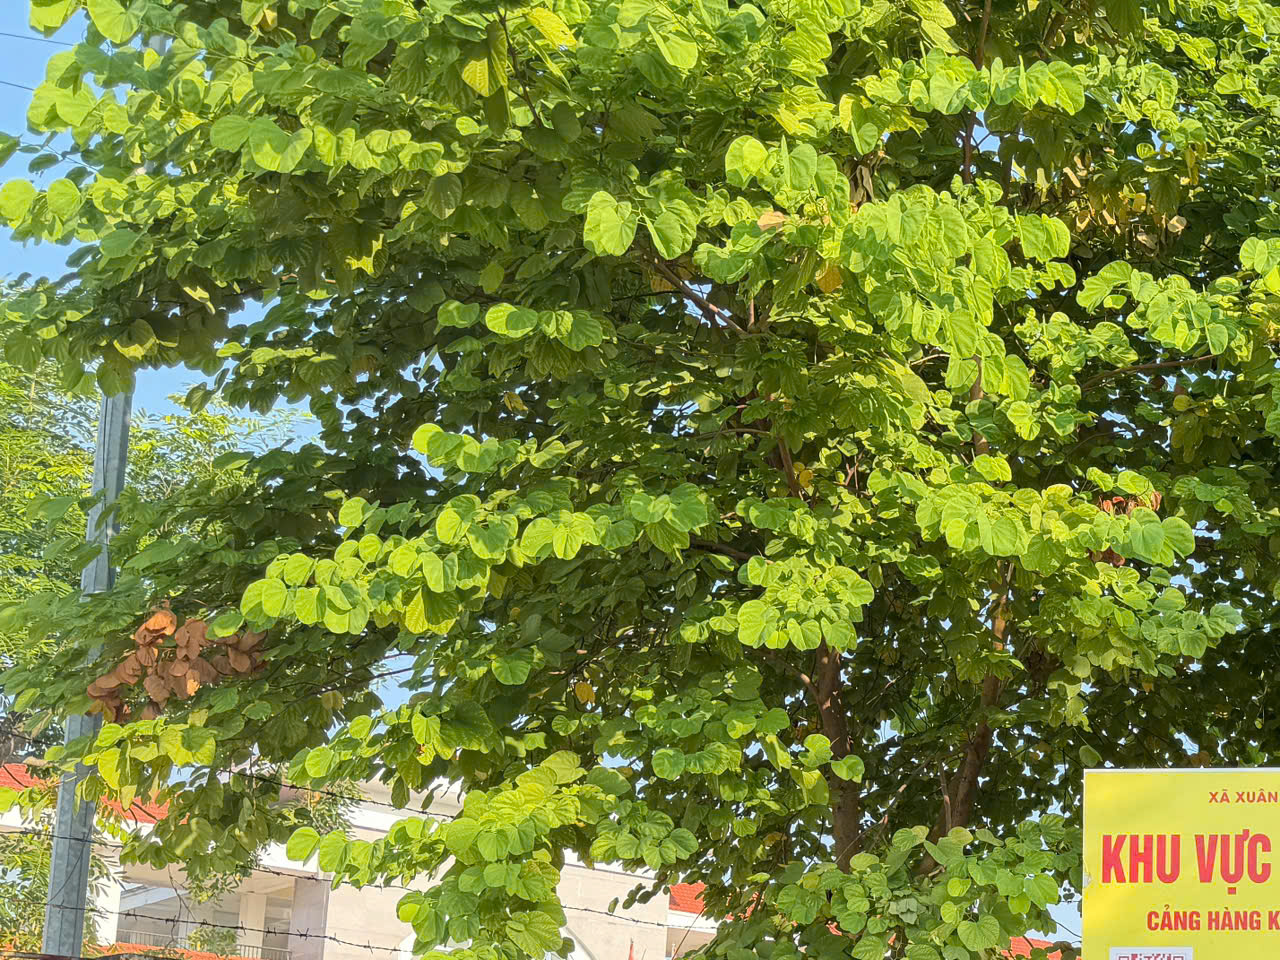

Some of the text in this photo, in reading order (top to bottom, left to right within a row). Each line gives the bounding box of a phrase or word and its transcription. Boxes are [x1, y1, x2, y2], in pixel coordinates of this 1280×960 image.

[1209, 789, 1231, 803] XÃ
[1235, 788, 1278, 803] XUÂN
[1101, 834, 1181, 884] KHU
[1194, 829, 1272, 895] VỰC
[1147, 904, 1201, 931] CẢNG
[1207, 906, 1261, 931] HÀNG
